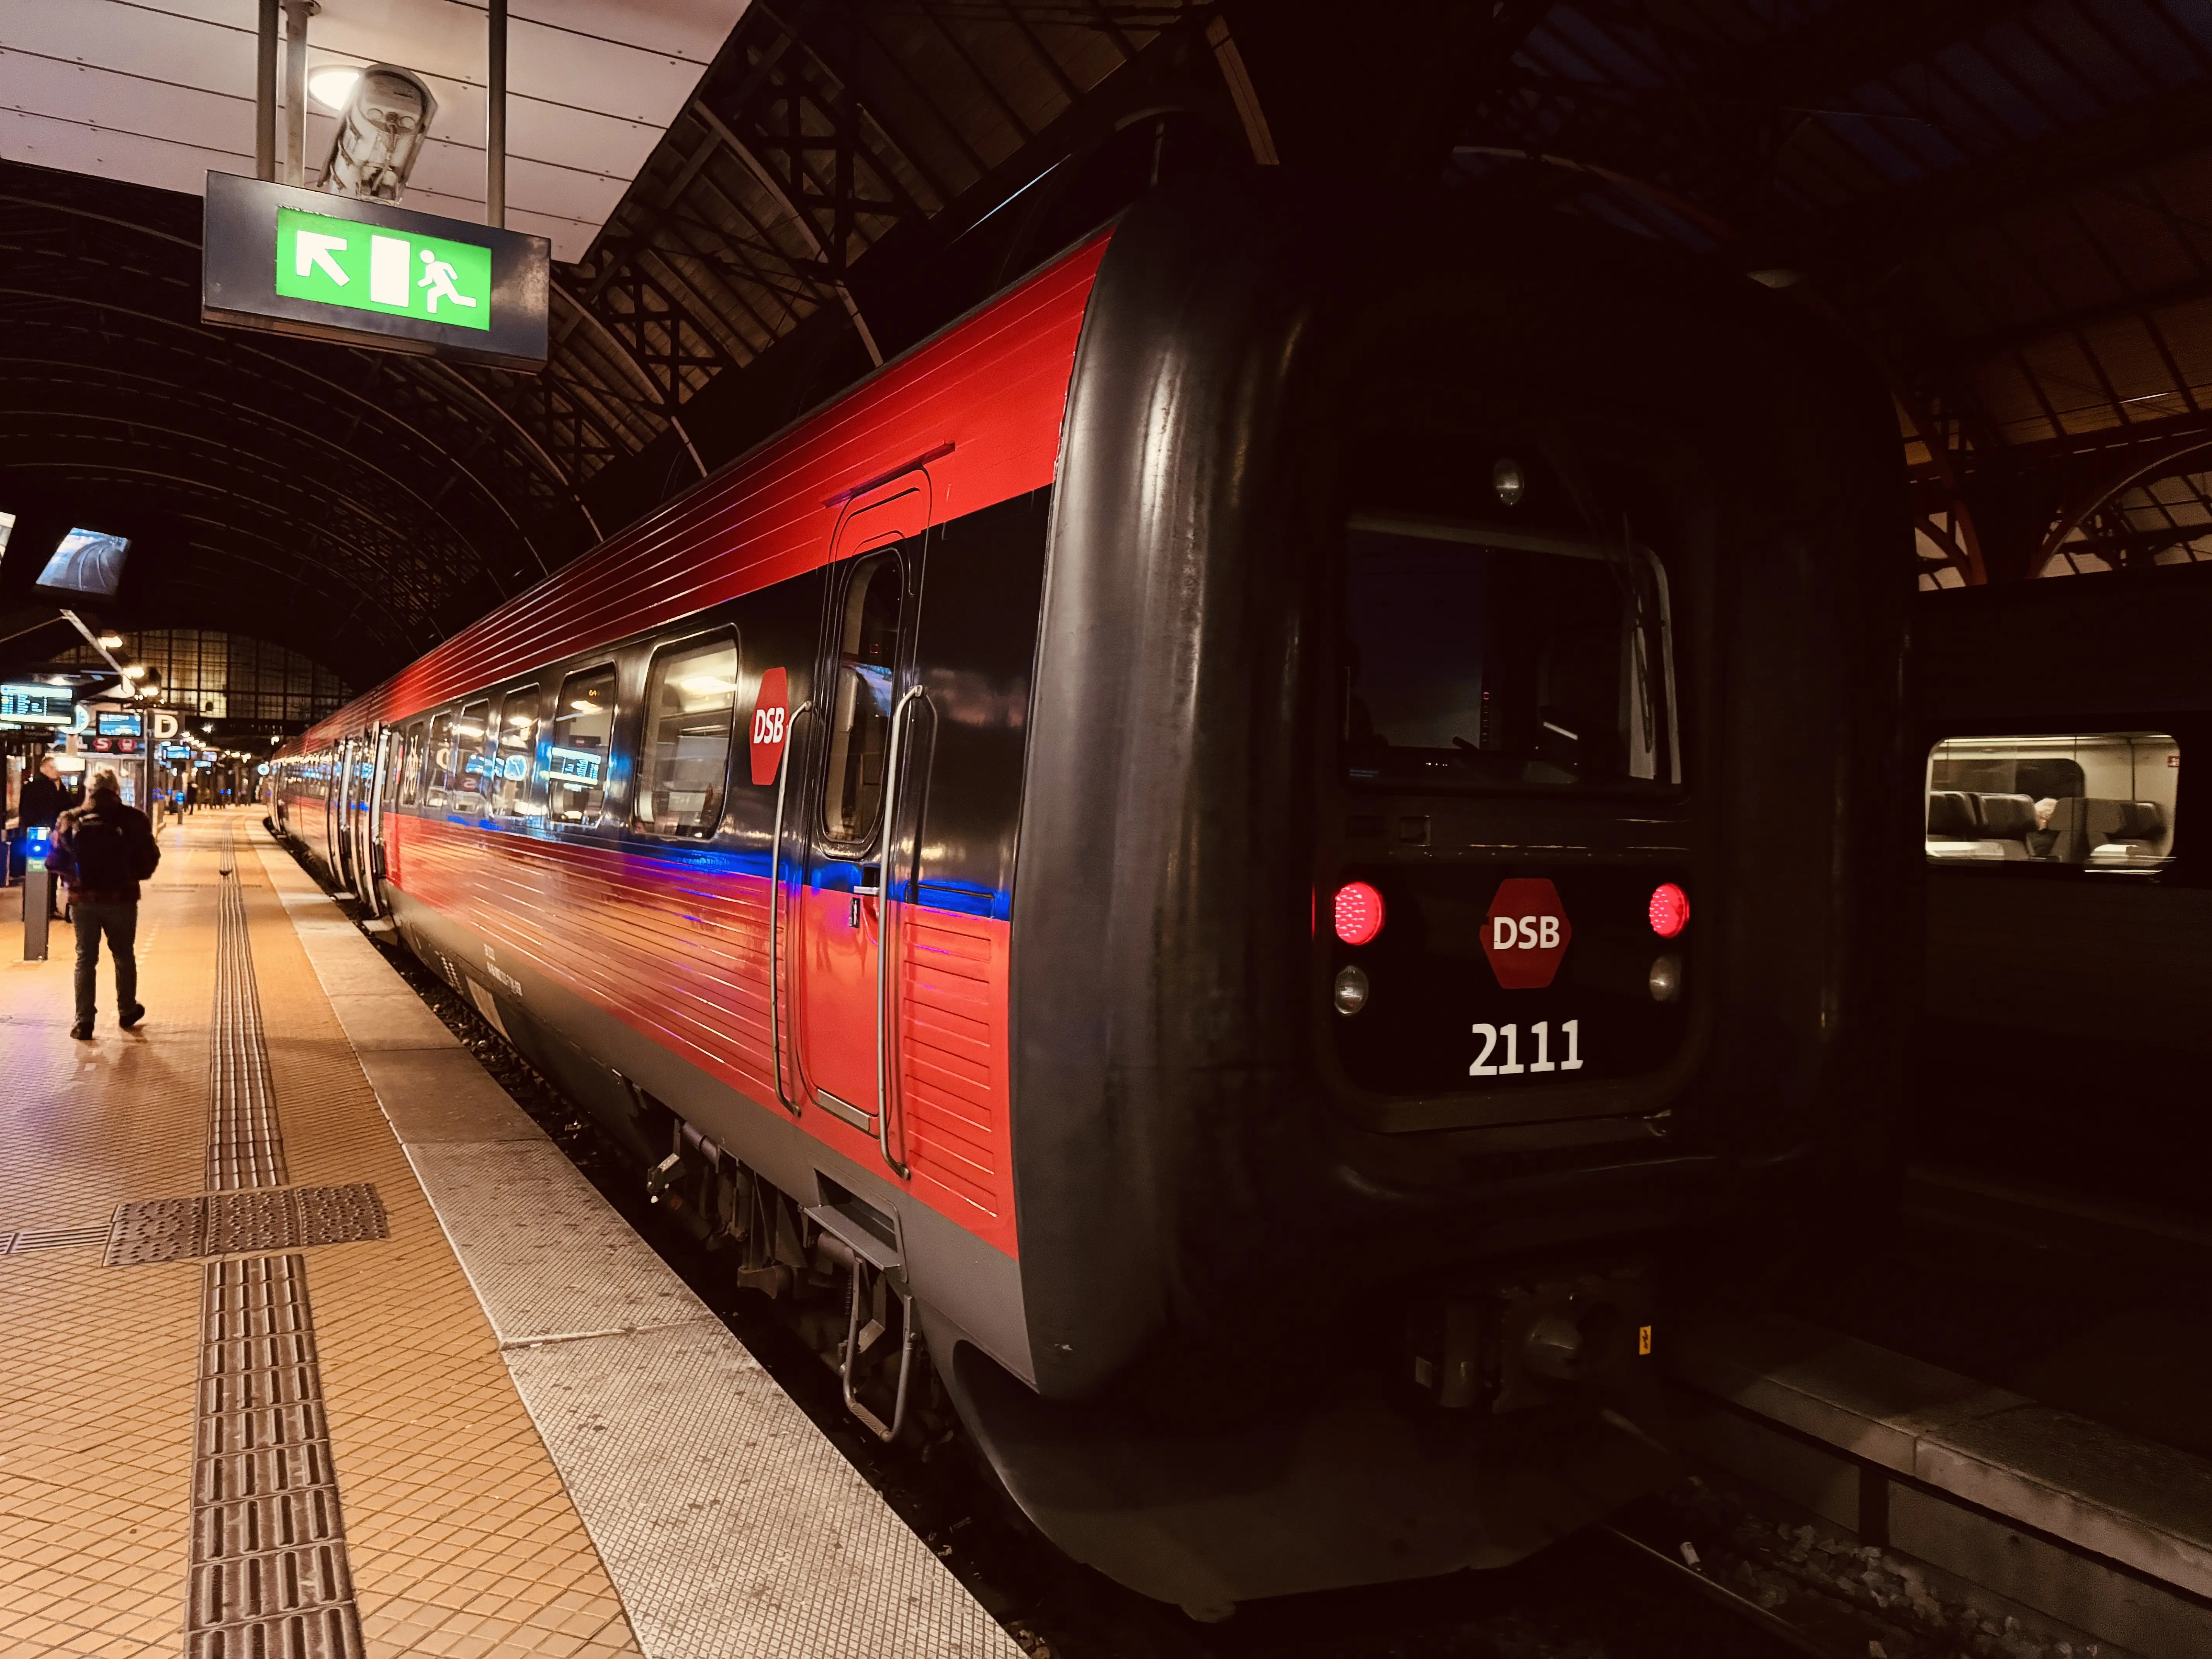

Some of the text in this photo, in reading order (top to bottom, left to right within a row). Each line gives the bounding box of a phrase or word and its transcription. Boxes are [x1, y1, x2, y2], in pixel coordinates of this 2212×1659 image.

[155, 714, 178, 738] D
[753, 707, 785, 744] DSB
[97, 737, 109, 748] S
[1493, 916, 1560, 949] DSB
[1469, 1019, 1583, 1076] 2111
